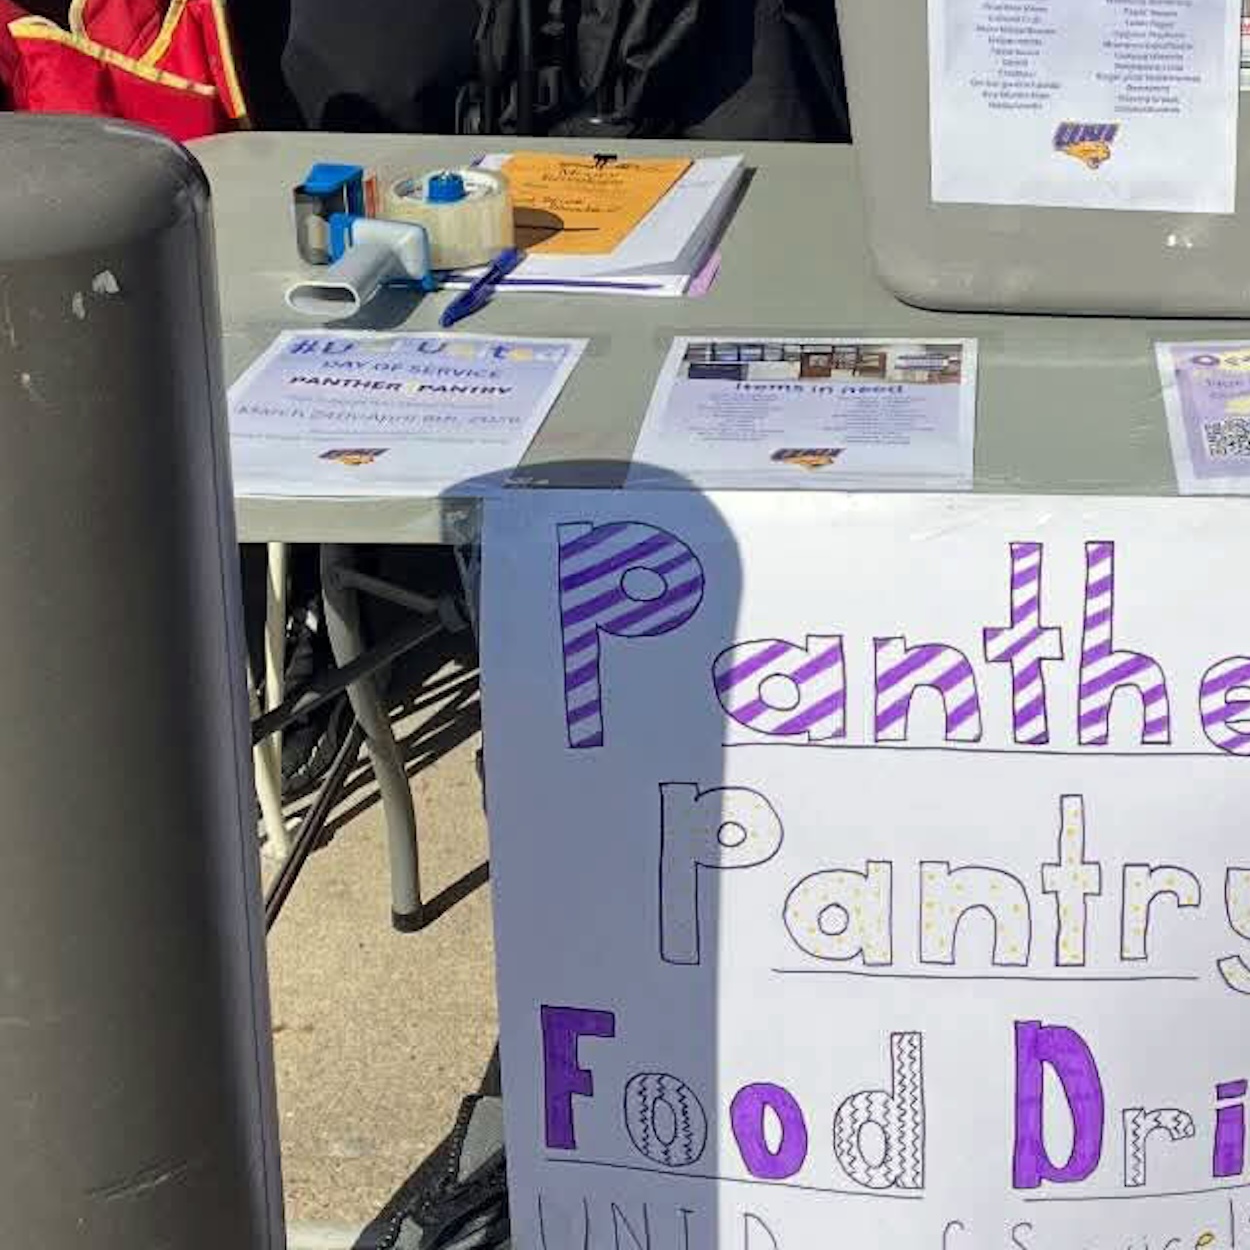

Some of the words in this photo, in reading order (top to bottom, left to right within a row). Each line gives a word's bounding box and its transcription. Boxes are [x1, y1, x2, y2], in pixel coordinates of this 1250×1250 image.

[320, 360, 367, 370] DAY
[373, 363, 402, 373] OF
[407, 365, 501, 379] SERVICE
[288, 375, 402, 391] PANTHER
[417, 383, 513, 395] PANTRY
[540, 1005, 925, 1190] Food
